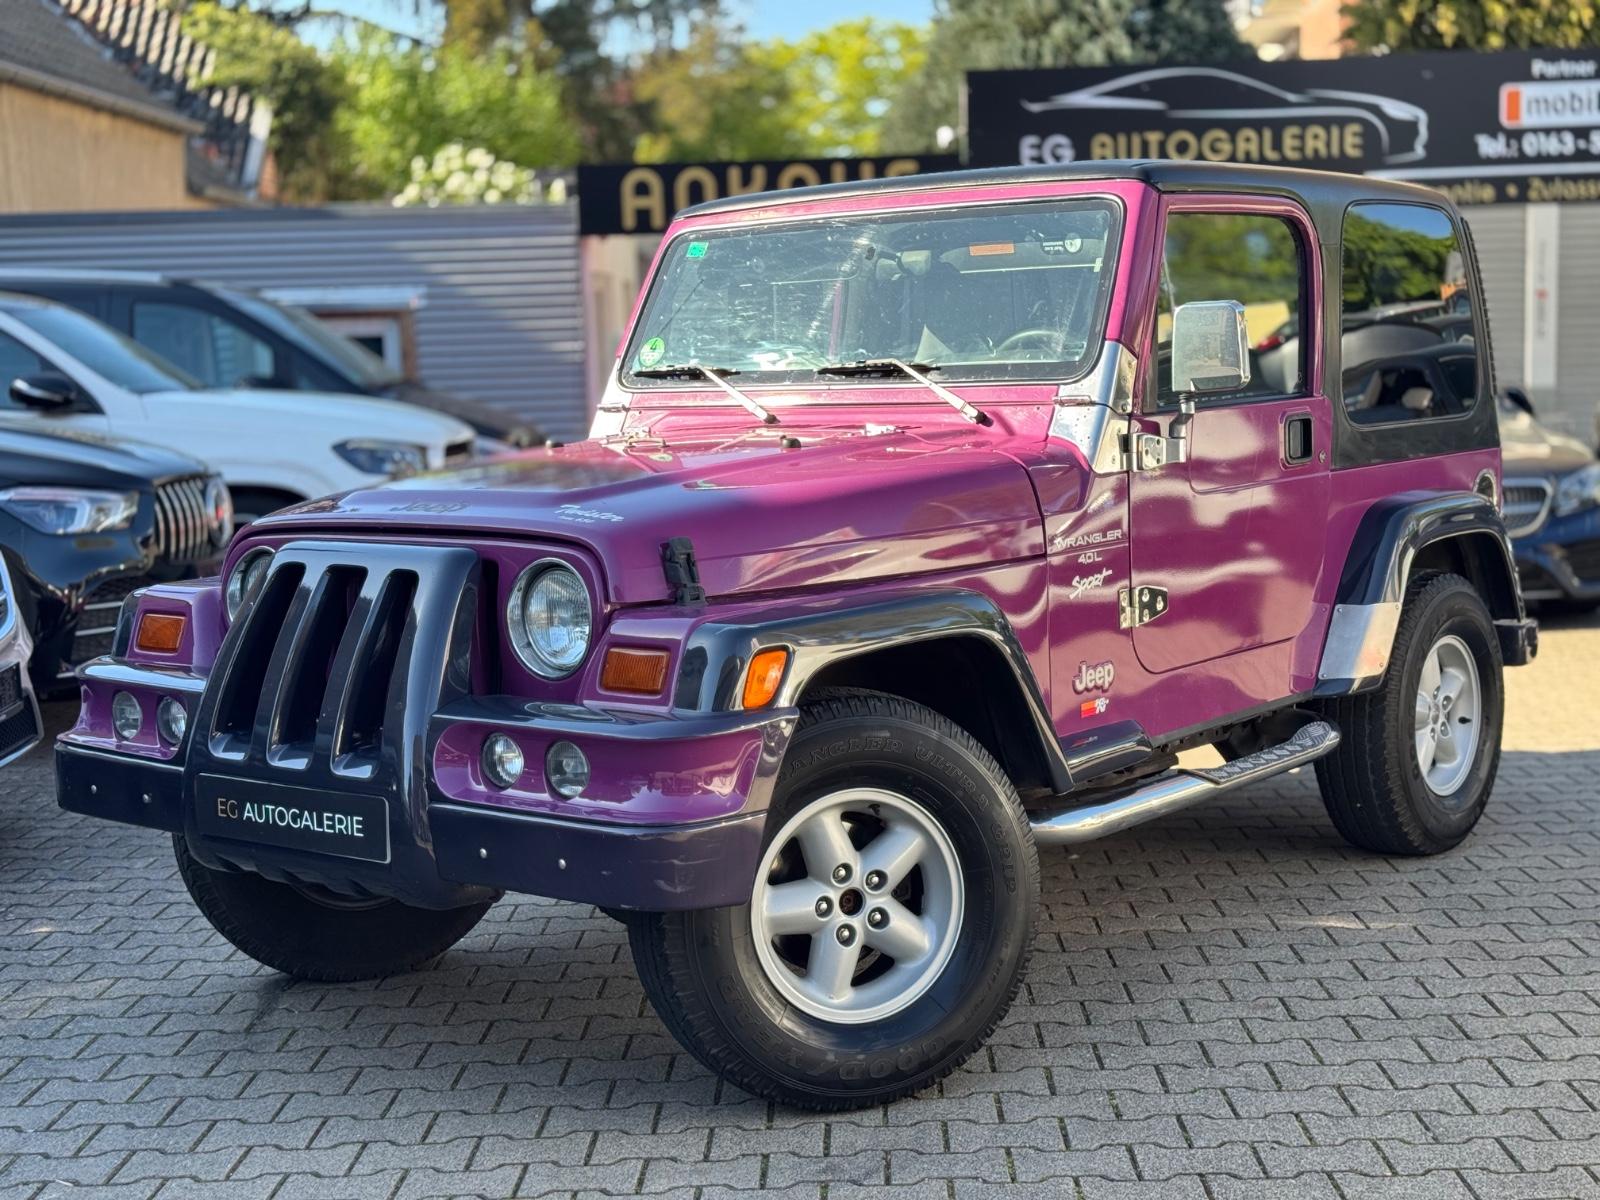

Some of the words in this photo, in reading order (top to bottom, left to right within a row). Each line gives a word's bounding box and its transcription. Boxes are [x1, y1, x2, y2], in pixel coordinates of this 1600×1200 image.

[1531, 58, 1597, 78] Partner
[1019, 134, 1075, 165] EG
[1090, 122, 1365, 162] AUTOGALERIE
[1054, 529, 1123, 549] WRANGLER
[1072, 661, 1114, 694] Jeep
[217, 798, 239, 819] EG
[243, 802, 365, 837] AUTOGALERIE
